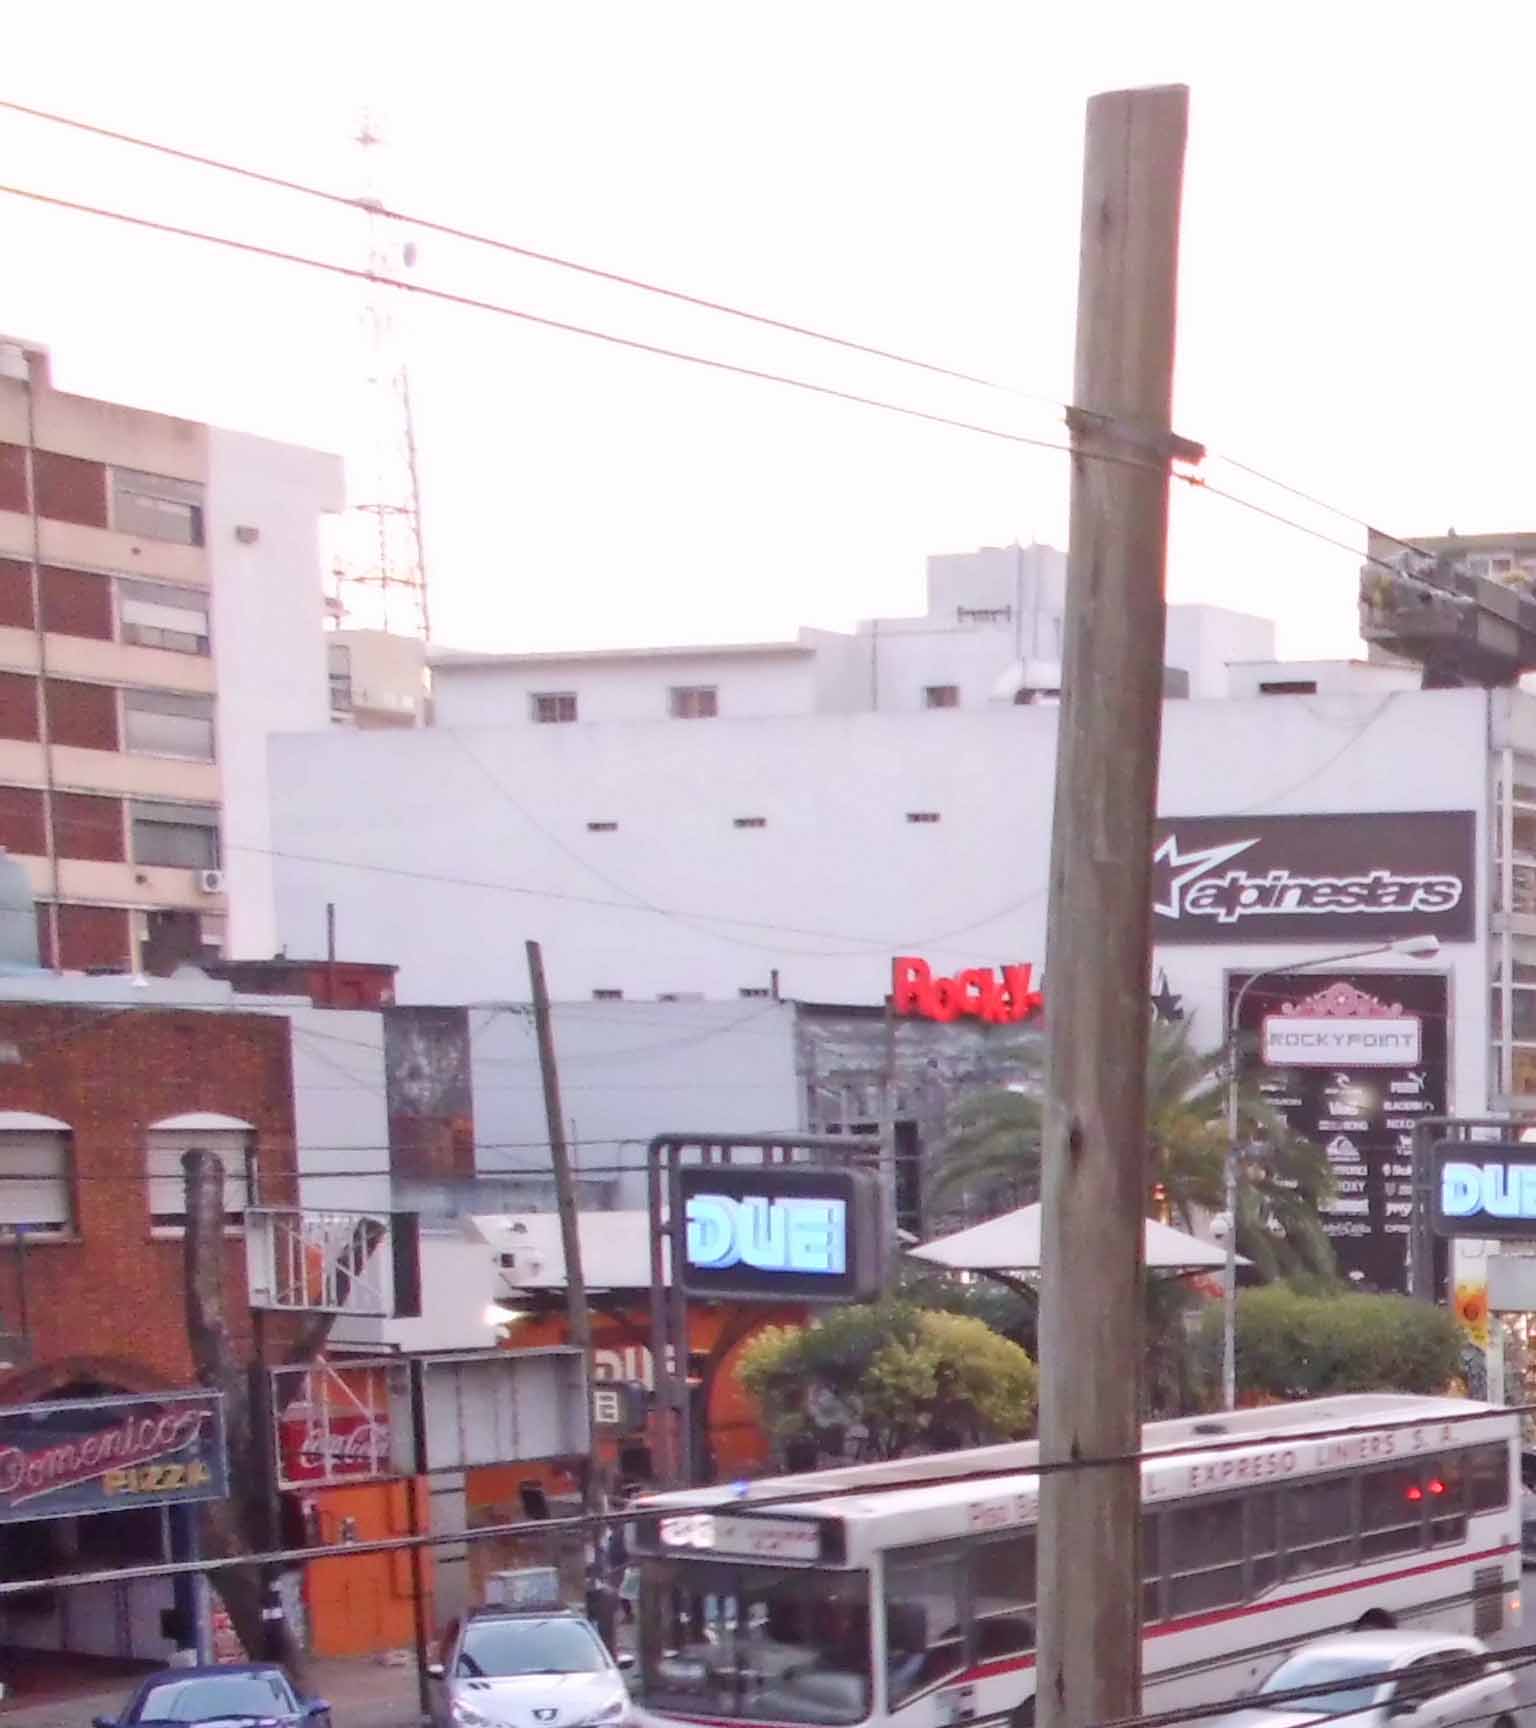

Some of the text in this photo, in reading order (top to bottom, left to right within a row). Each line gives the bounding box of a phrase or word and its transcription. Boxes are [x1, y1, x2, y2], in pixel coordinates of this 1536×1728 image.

[1185, 870, 1463, 923] alpinestars
[685, 1193, 847, 1274] DUE
[1188, 1449, 1297, 1489] EXPRESO
